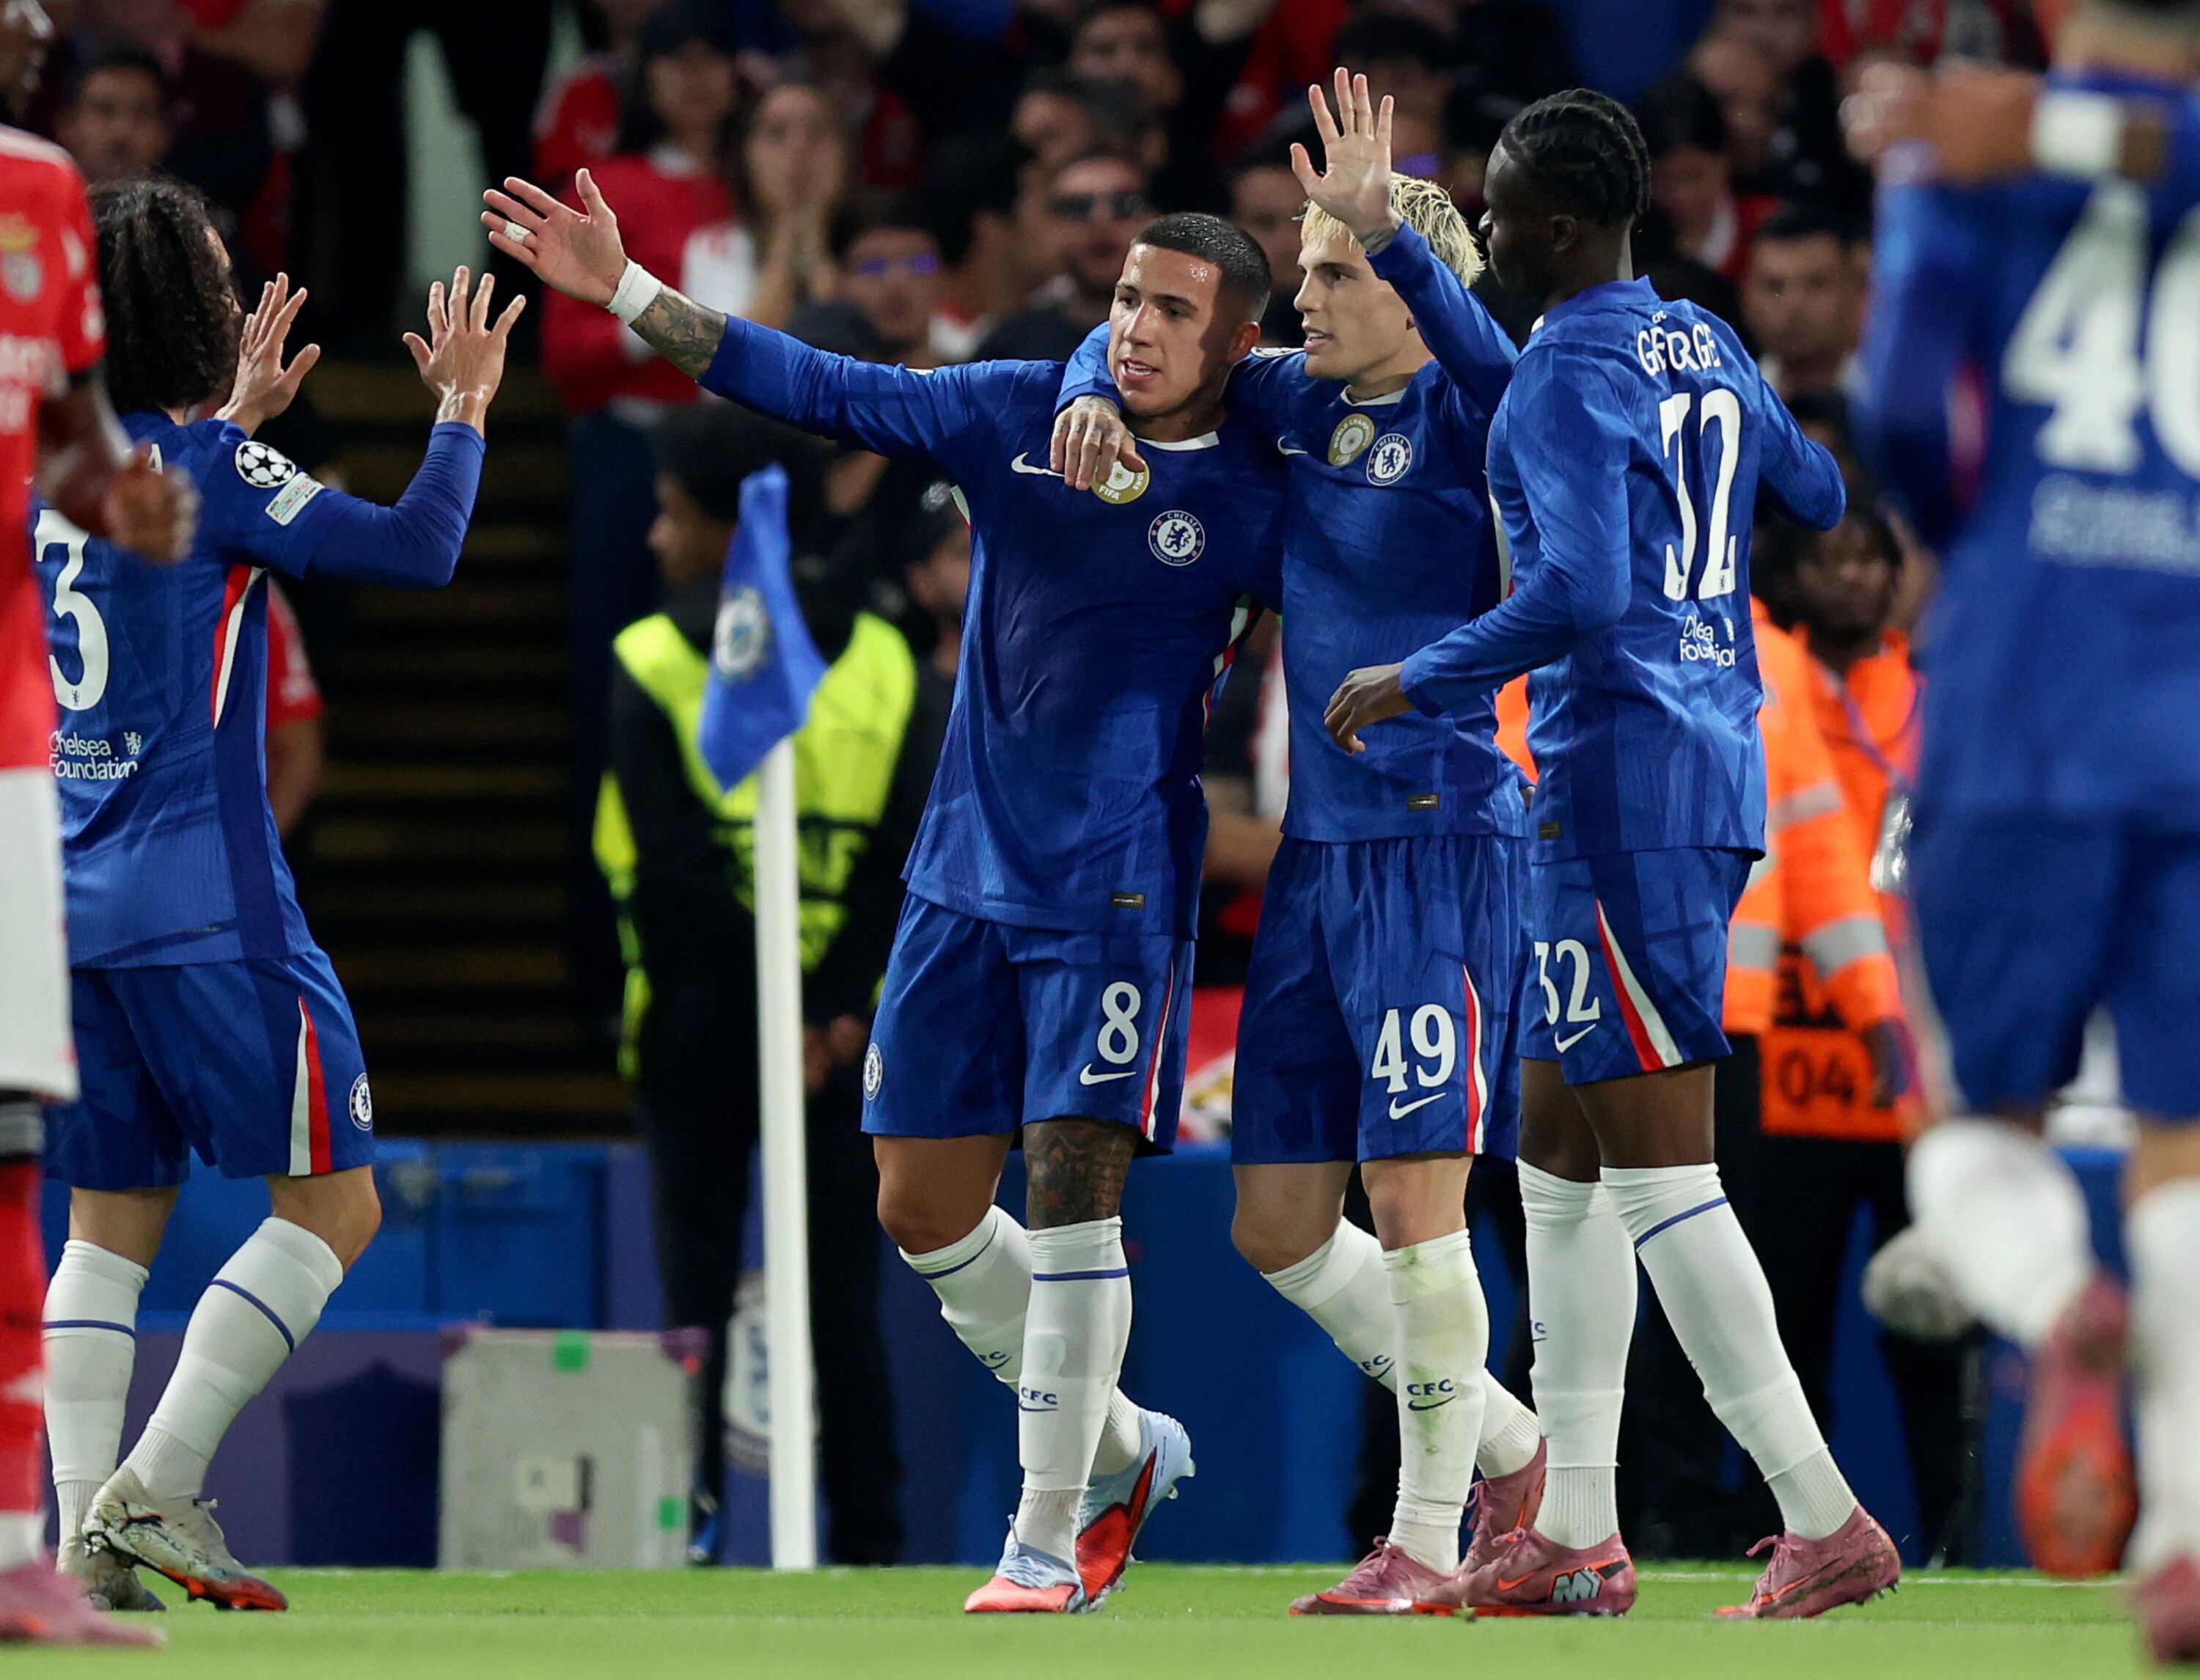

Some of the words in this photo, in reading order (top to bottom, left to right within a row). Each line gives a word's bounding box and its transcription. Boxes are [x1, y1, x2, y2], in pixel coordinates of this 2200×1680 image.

[1099, 484, 1121, 501] FIFA
[1167, 513, 1200, 533] CHELSEA
[34, 509, 109, 711] 3
[48, 730, 111, 756] Chelsea
[48, 753, 138, 780] Foundation
[1534, 939, 1600, 1025] 32
[1097, 981, 1141, 1064] 8
[1371, 1003, 1456, 1093] 49
[1021, 1387, 1058, 1405] CFC
[1407, 1379, 1454, 1395] CFC
